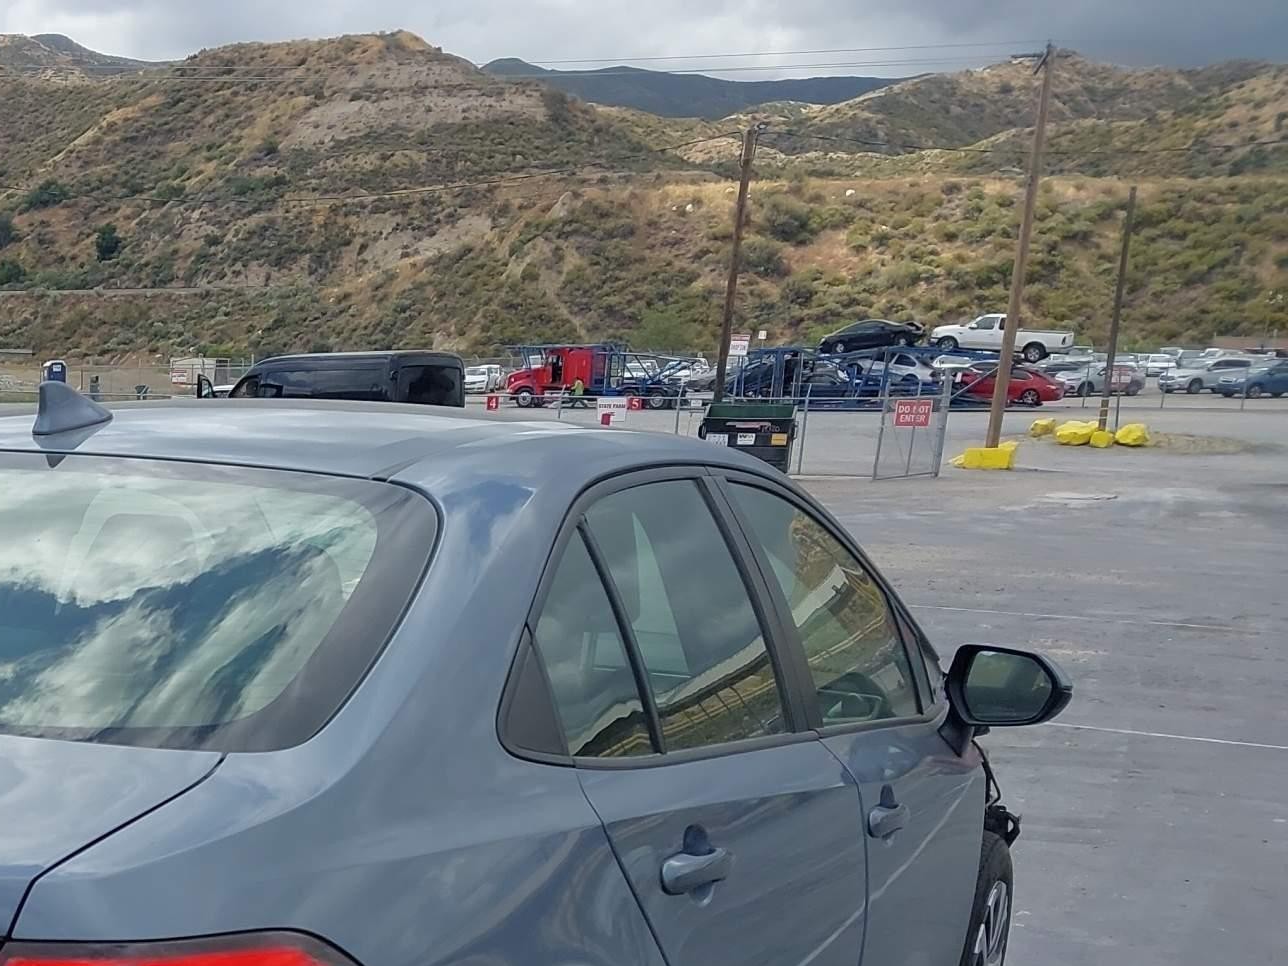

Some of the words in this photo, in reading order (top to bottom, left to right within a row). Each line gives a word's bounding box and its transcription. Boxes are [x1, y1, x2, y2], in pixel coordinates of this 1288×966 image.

[489, 397, 497, 408] 4
[631, 398, 640, 409] 5
[898, 405, 911, 413] DO
